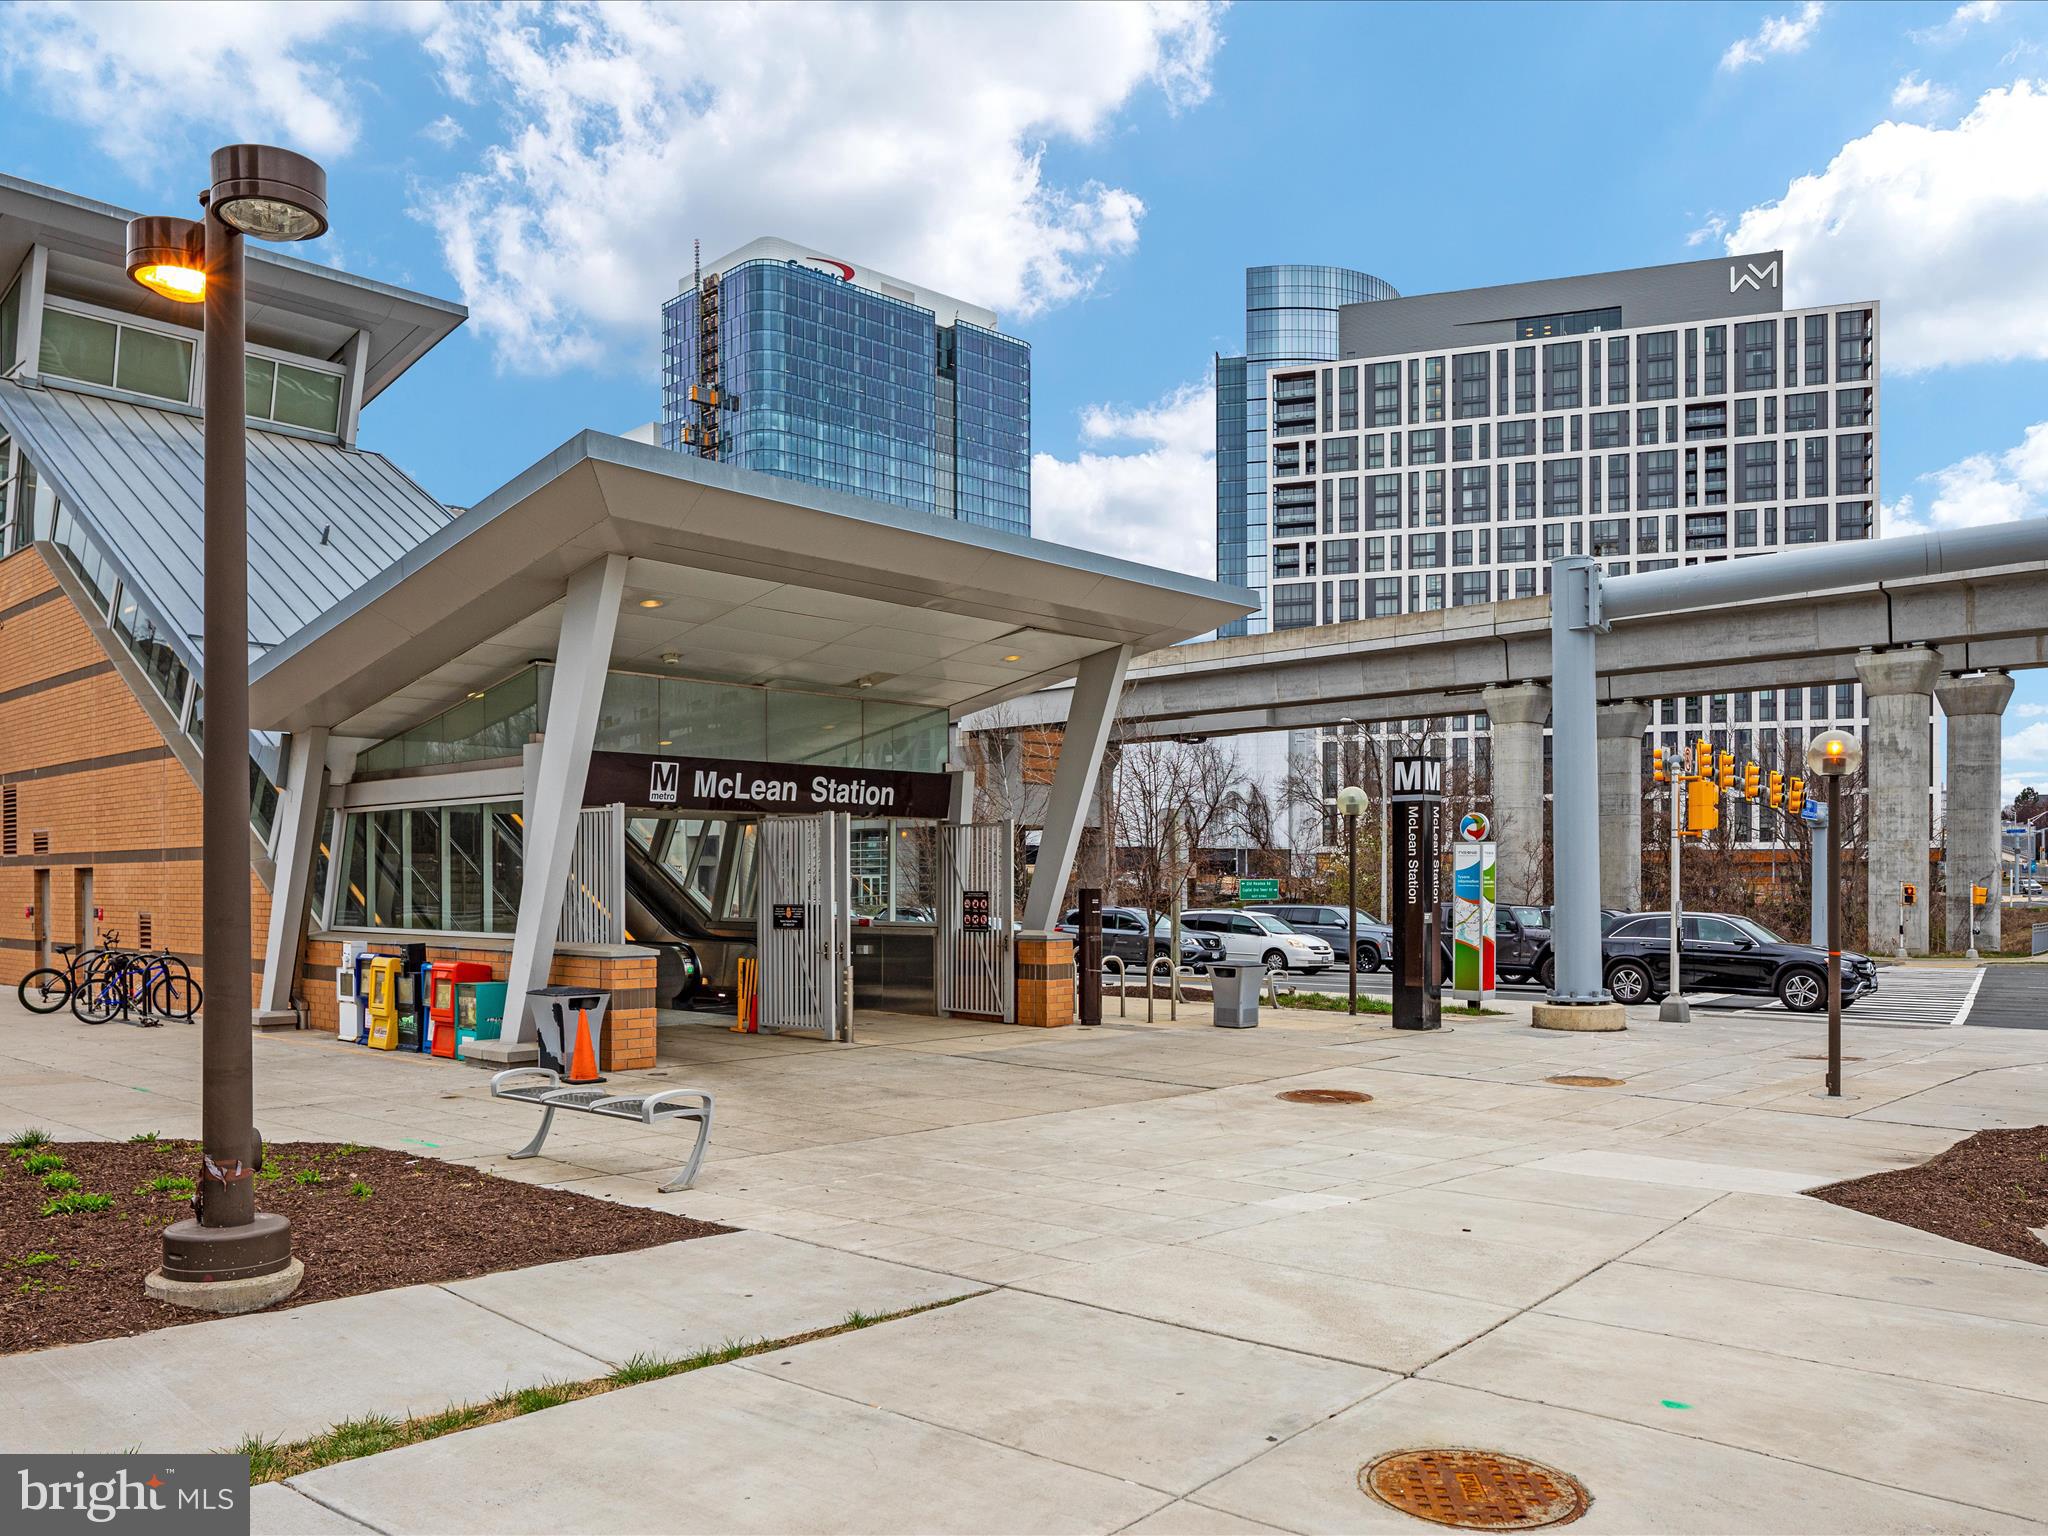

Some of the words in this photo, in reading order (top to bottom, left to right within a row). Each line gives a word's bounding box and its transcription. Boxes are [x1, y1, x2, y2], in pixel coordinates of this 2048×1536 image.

[693, 770, 798, 802] McLean
[811, 776, 895, 806] Station
[1394, 761, 1421, 791] M
[1424, 761, 1441, 791] M
[651, 792, 675, 801] metro
[1408, 806, 1419, 856] McLean
[1408, 860, 1419, 904] Station
